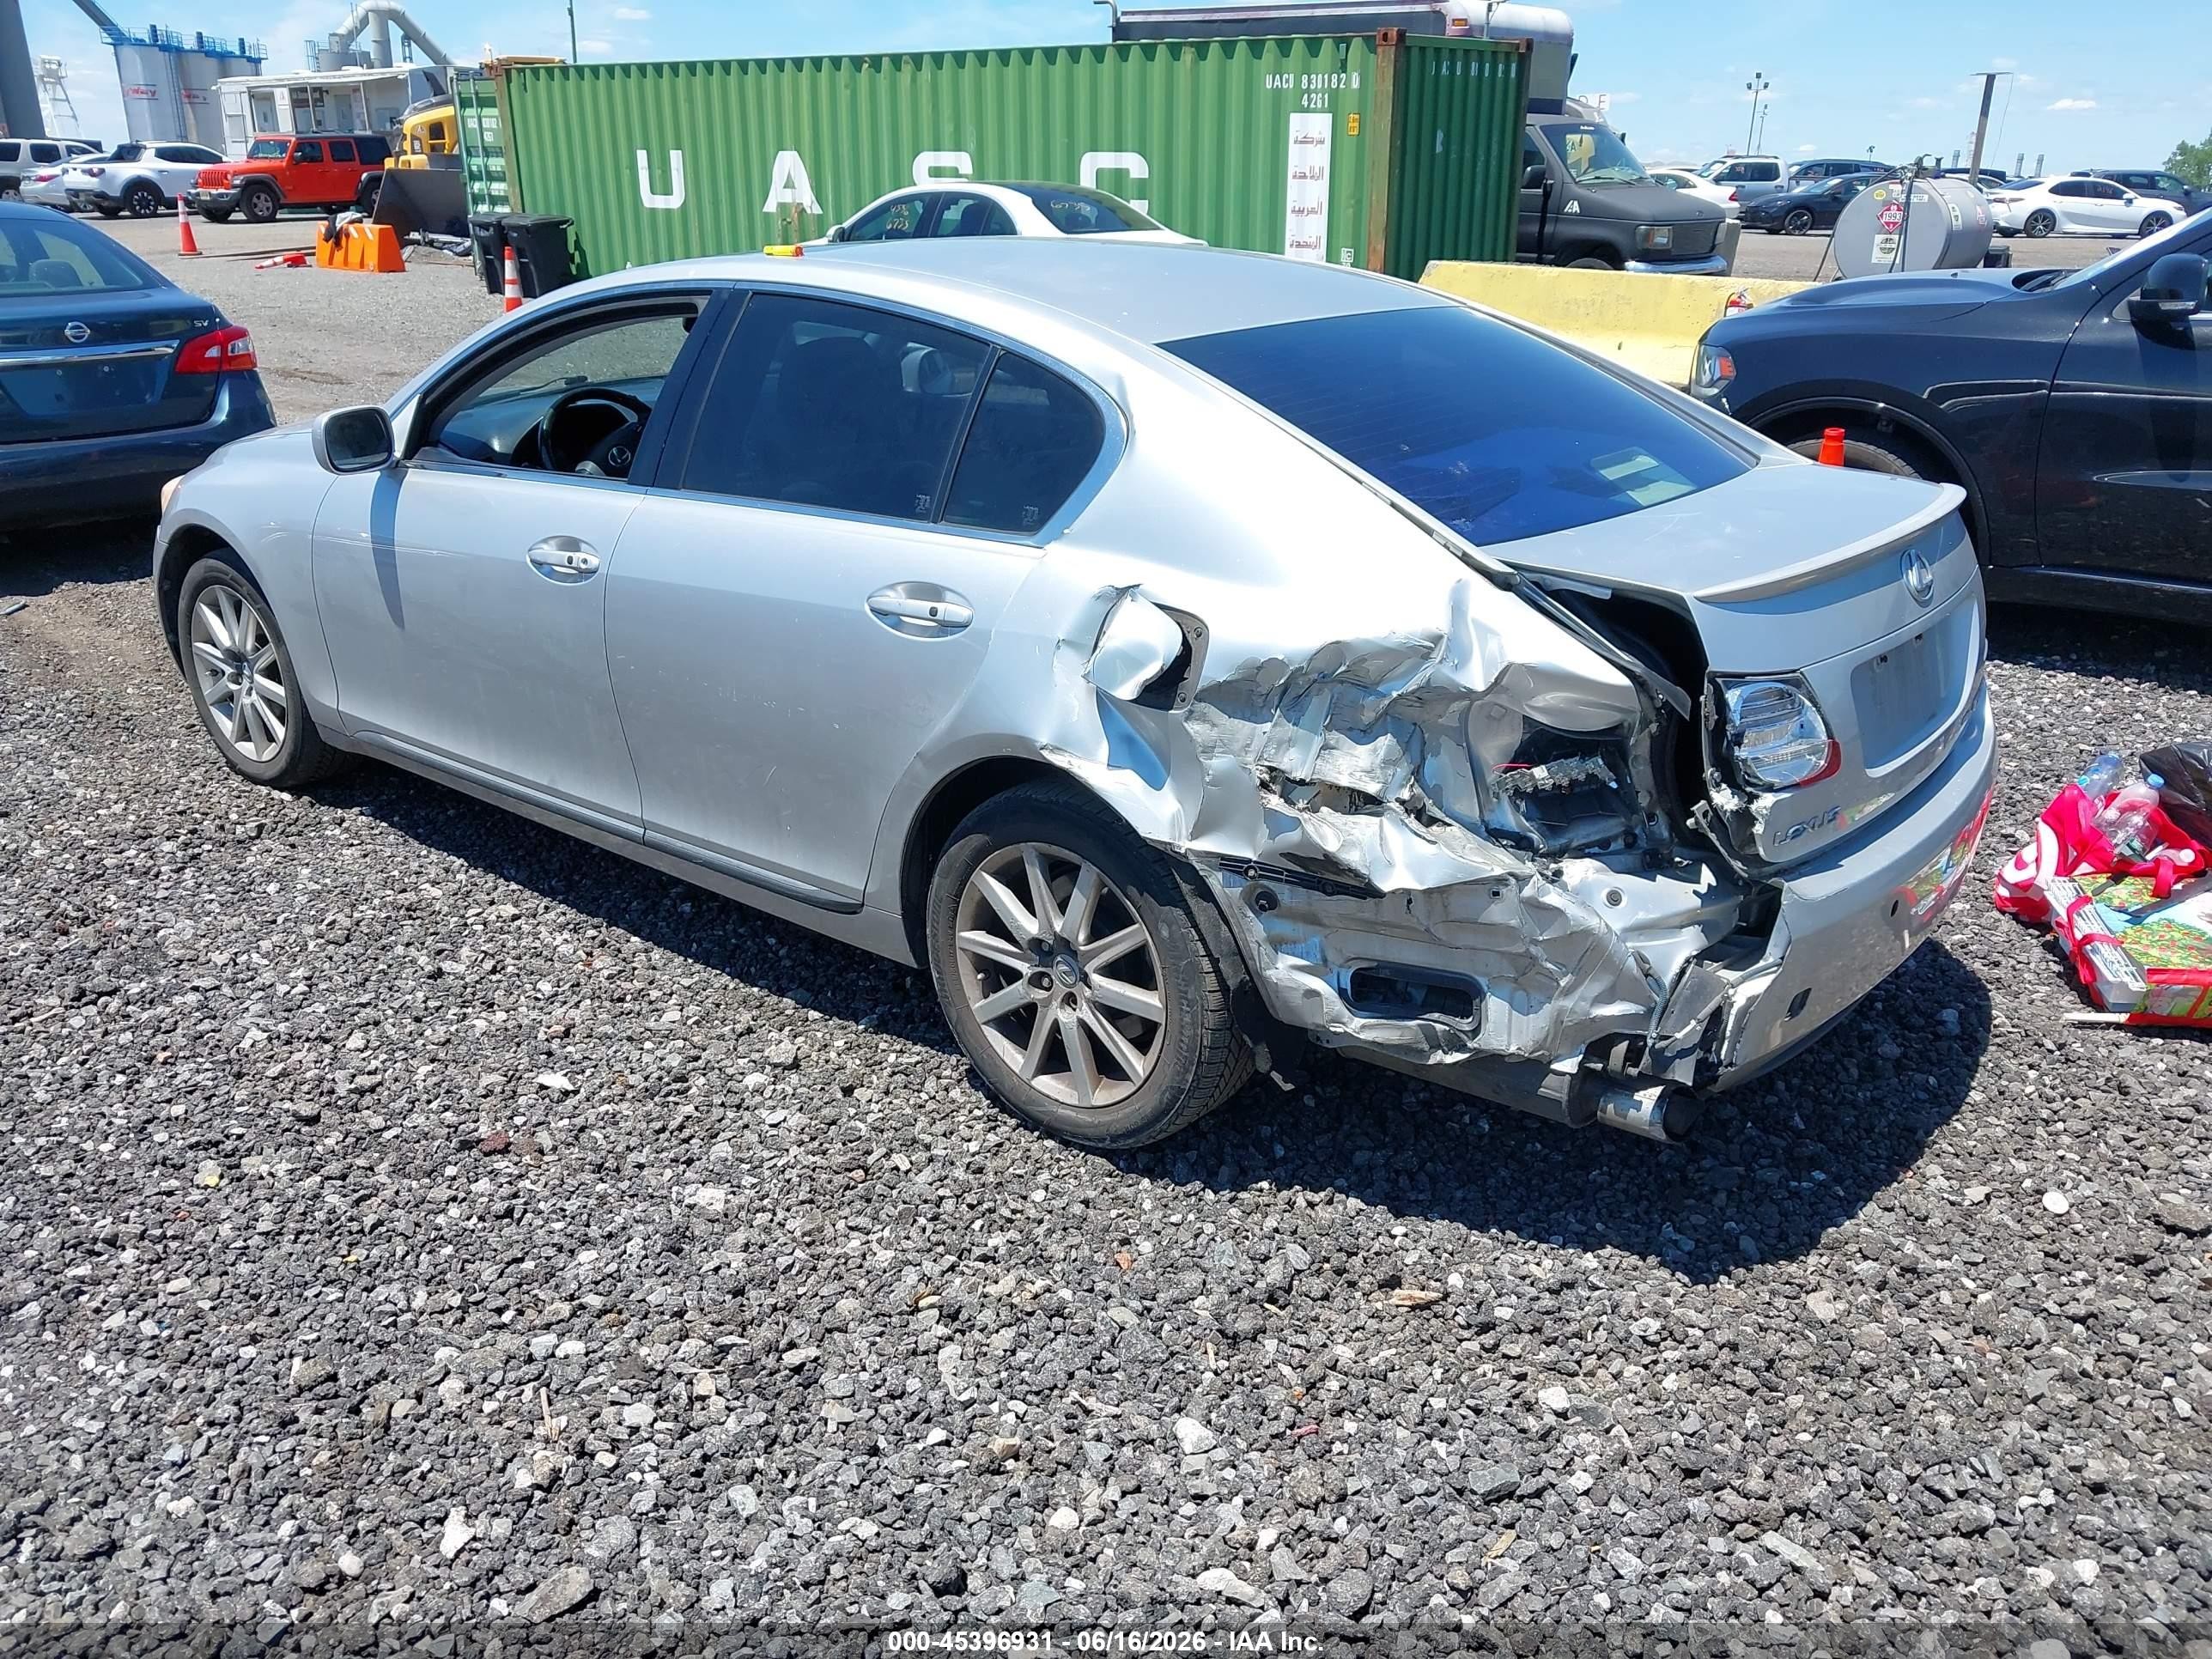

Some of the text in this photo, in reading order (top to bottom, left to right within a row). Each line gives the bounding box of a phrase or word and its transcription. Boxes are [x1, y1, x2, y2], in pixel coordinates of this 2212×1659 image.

[1266, 73, 1295, 88] UACU
[1301, 73, 1346, 89] 830182
[1293, 131, 1325, 148] شركة
[1291, 165, 1324, 181] الملاحة
[1291, 196, 1322, 216] العربية
[1884, 212, 1902, 221] 1993
[1289, 234, 1322, 250] المتحدة
[1773, 805, 1842, 847] LEXUS
